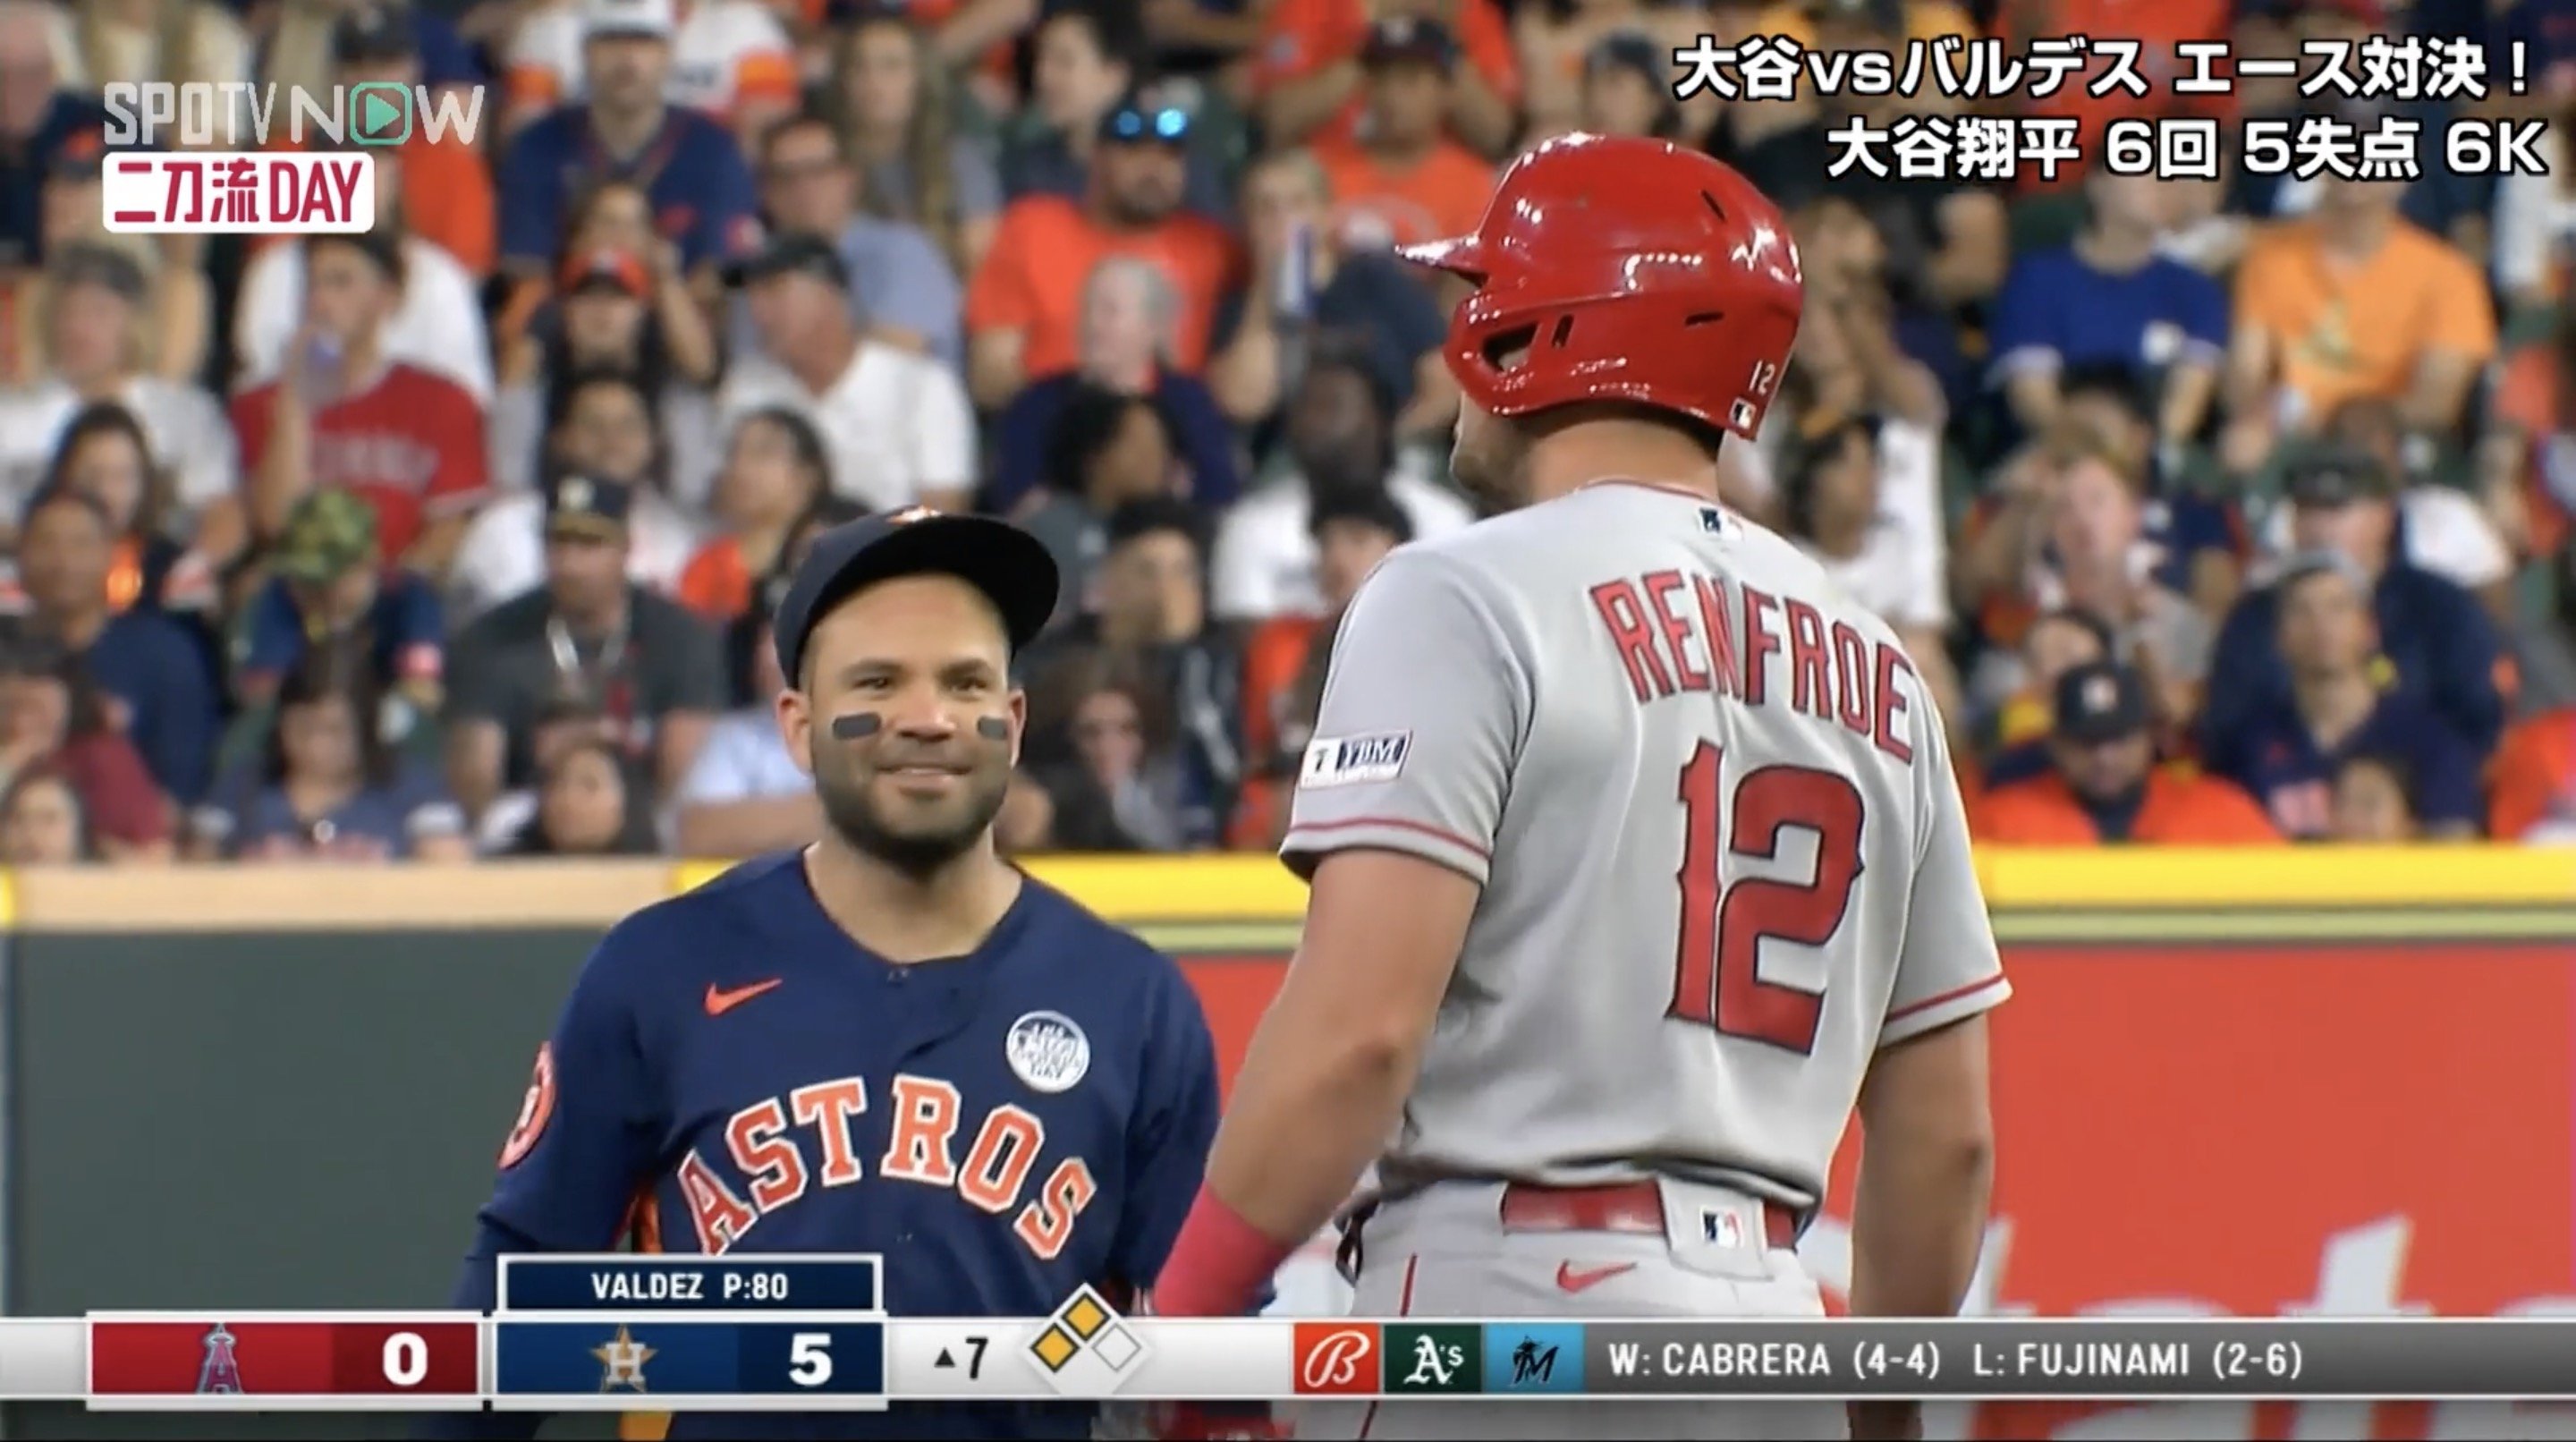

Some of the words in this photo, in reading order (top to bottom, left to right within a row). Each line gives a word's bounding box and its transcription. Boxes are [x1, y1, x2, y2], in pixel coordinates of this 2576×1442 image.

[1749, 359, 1776, 395] 12
[1591, 568, 1915, 765] RENFROE
[1664, 738, 1865, 1056] 12
[677, 1073, 1097, 1260] ASTROS
